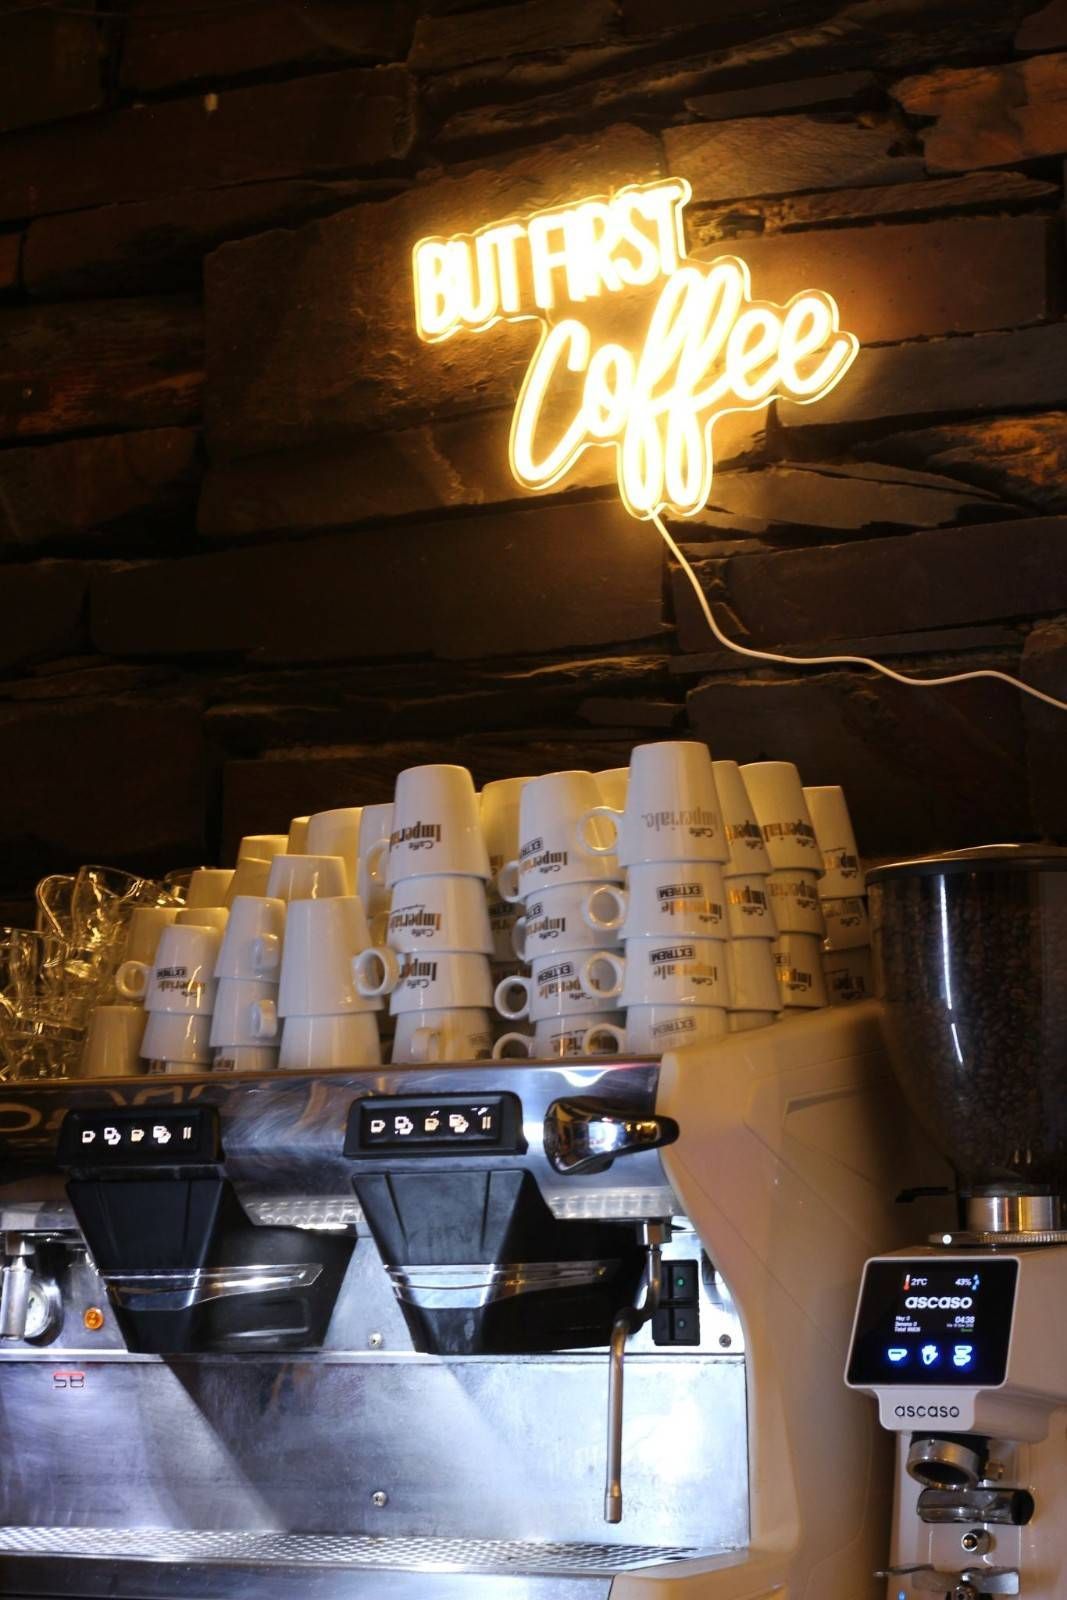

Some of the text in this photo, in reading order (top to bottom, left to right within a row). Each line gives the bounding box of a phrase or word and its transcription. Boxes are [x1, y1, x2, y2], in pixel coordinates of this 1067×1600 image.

[416, 186, 684, 335] BUT FIRST
[513, 265, 850, 511] Coffee
[658, 884, 703, 900] EXTREM
[651, 947, 694, 964] EXTREM
[905, 1297, 973, 1309] ascaso
[894, 1406, 960, 1418] ascaso
